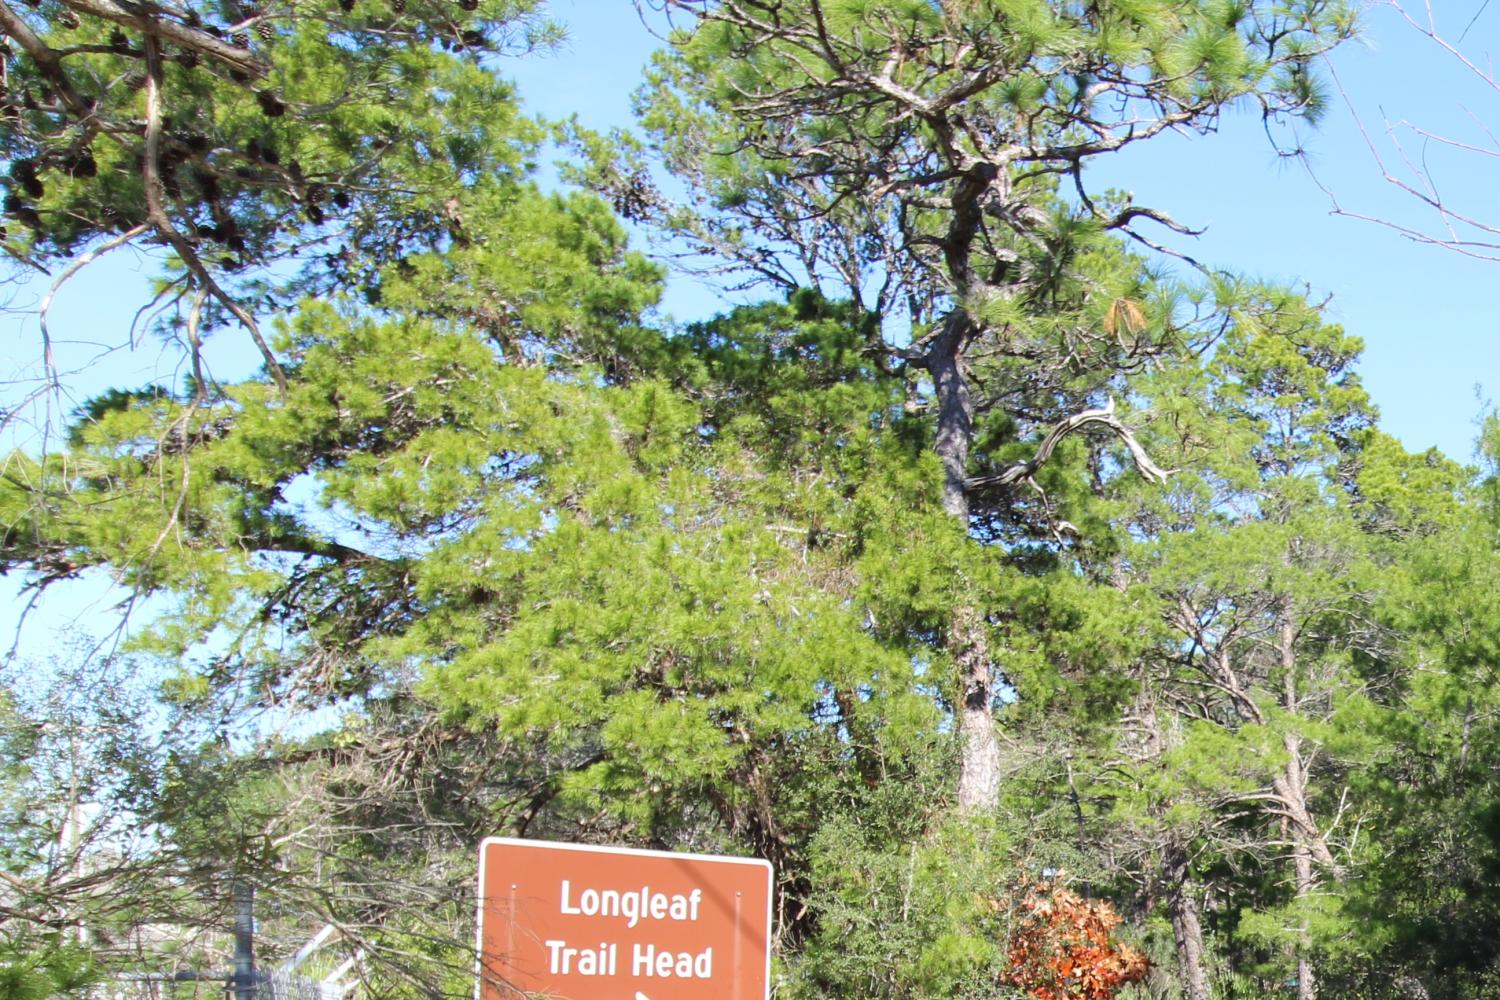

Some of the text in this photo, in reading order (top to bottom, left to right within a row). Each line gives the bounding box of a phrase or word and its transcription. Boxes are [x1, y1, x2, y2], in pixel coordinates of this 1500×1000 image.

[560, 880, 702, 929] Longleaf
[546, 940, 713, 979] Trail Head
